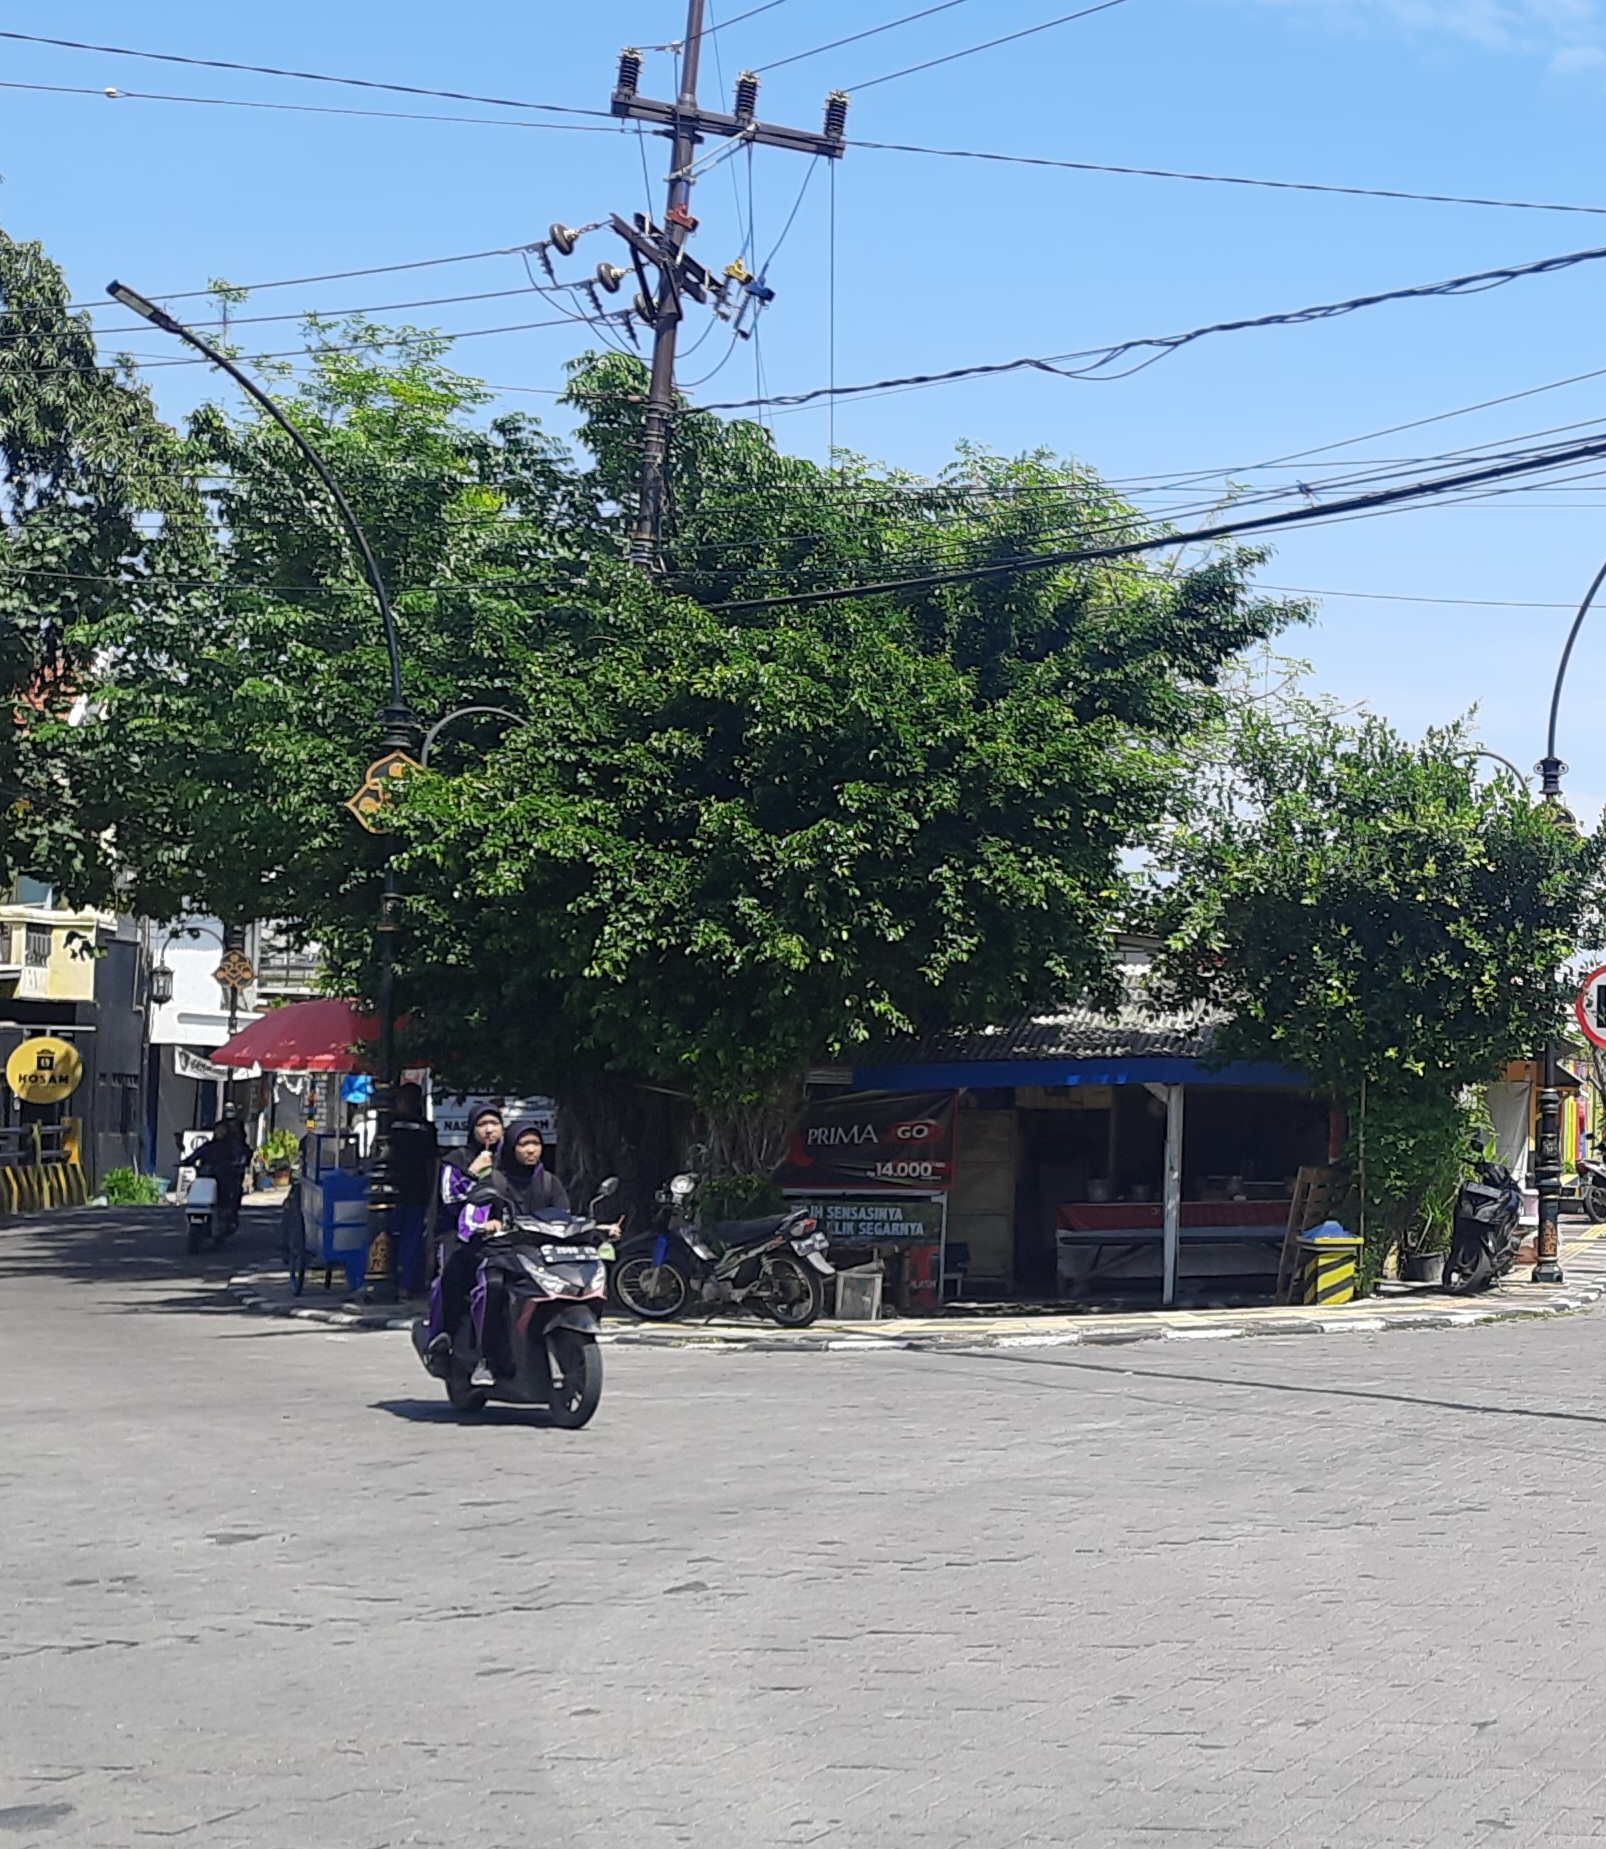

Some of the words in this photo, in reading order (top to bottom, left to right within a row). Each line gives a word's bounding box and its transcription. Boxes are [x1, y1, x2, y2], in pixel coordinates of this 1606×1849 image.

[806, 1123, 879, 1146] PRIMA
[897, 1124, 929, 1139] GO
[874, 1161, 933, 1178] 14.000
[827, 1206, 904, 1221] SENSASINYA
[858, 1222, 925, 1236] SEGARNYA
